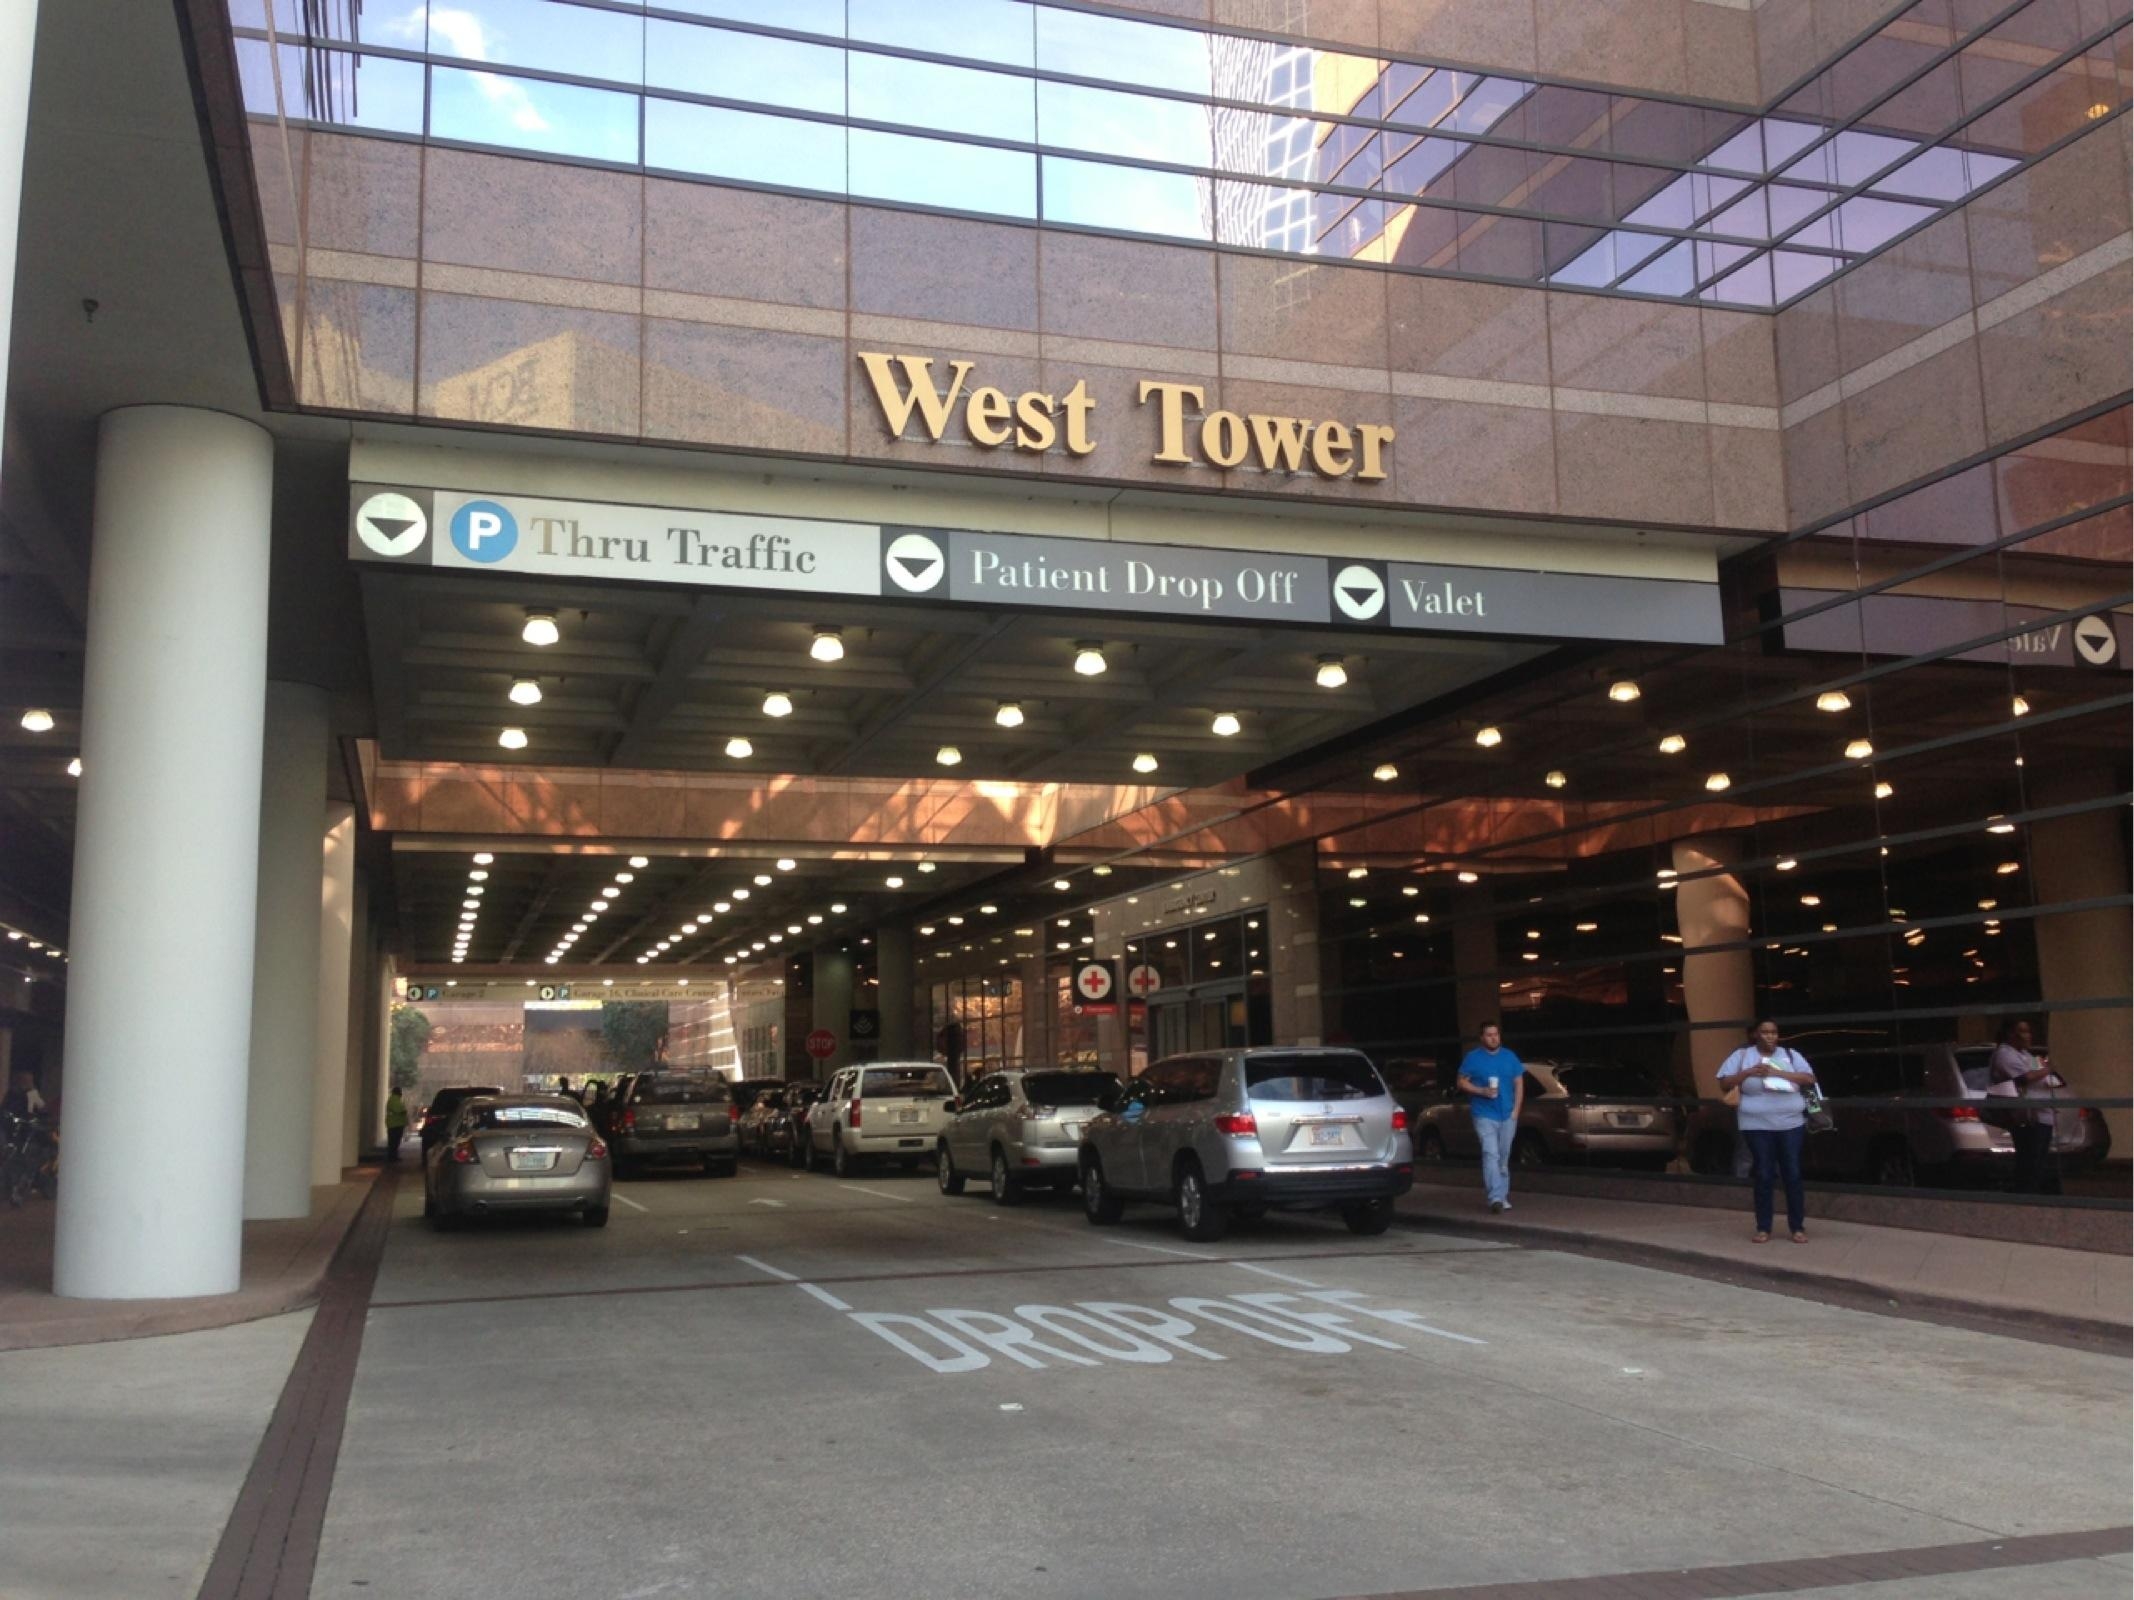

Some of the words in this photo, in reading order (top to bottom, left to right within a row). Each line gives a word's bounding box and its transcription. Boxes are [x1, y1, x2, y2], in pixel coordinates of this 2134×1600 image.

[857, 351, 1097, 455] West
[1137, 379, 1395, 482] Tower
[468, 511, 502, 551] P
[530, 517, 651, 564] Thru
[667, 527, 816, 574] Traffic
[970, 550, 1112, 594] Patient
[1124, 560, 1223, 609] Drop
[1236, 566, 1299, 605] Off
[1401, 580, 1487, 617] Valet
[573, 988, 607, 1000] Garage
[625, 988, 659, 998] Clinical
[661, 988, 684, 998] Care
[808, 1036, 834, 1049] STOP
[846, 1301, 1228, 1373] DROP
[1168, 1290, 1489, 1353] OFF
